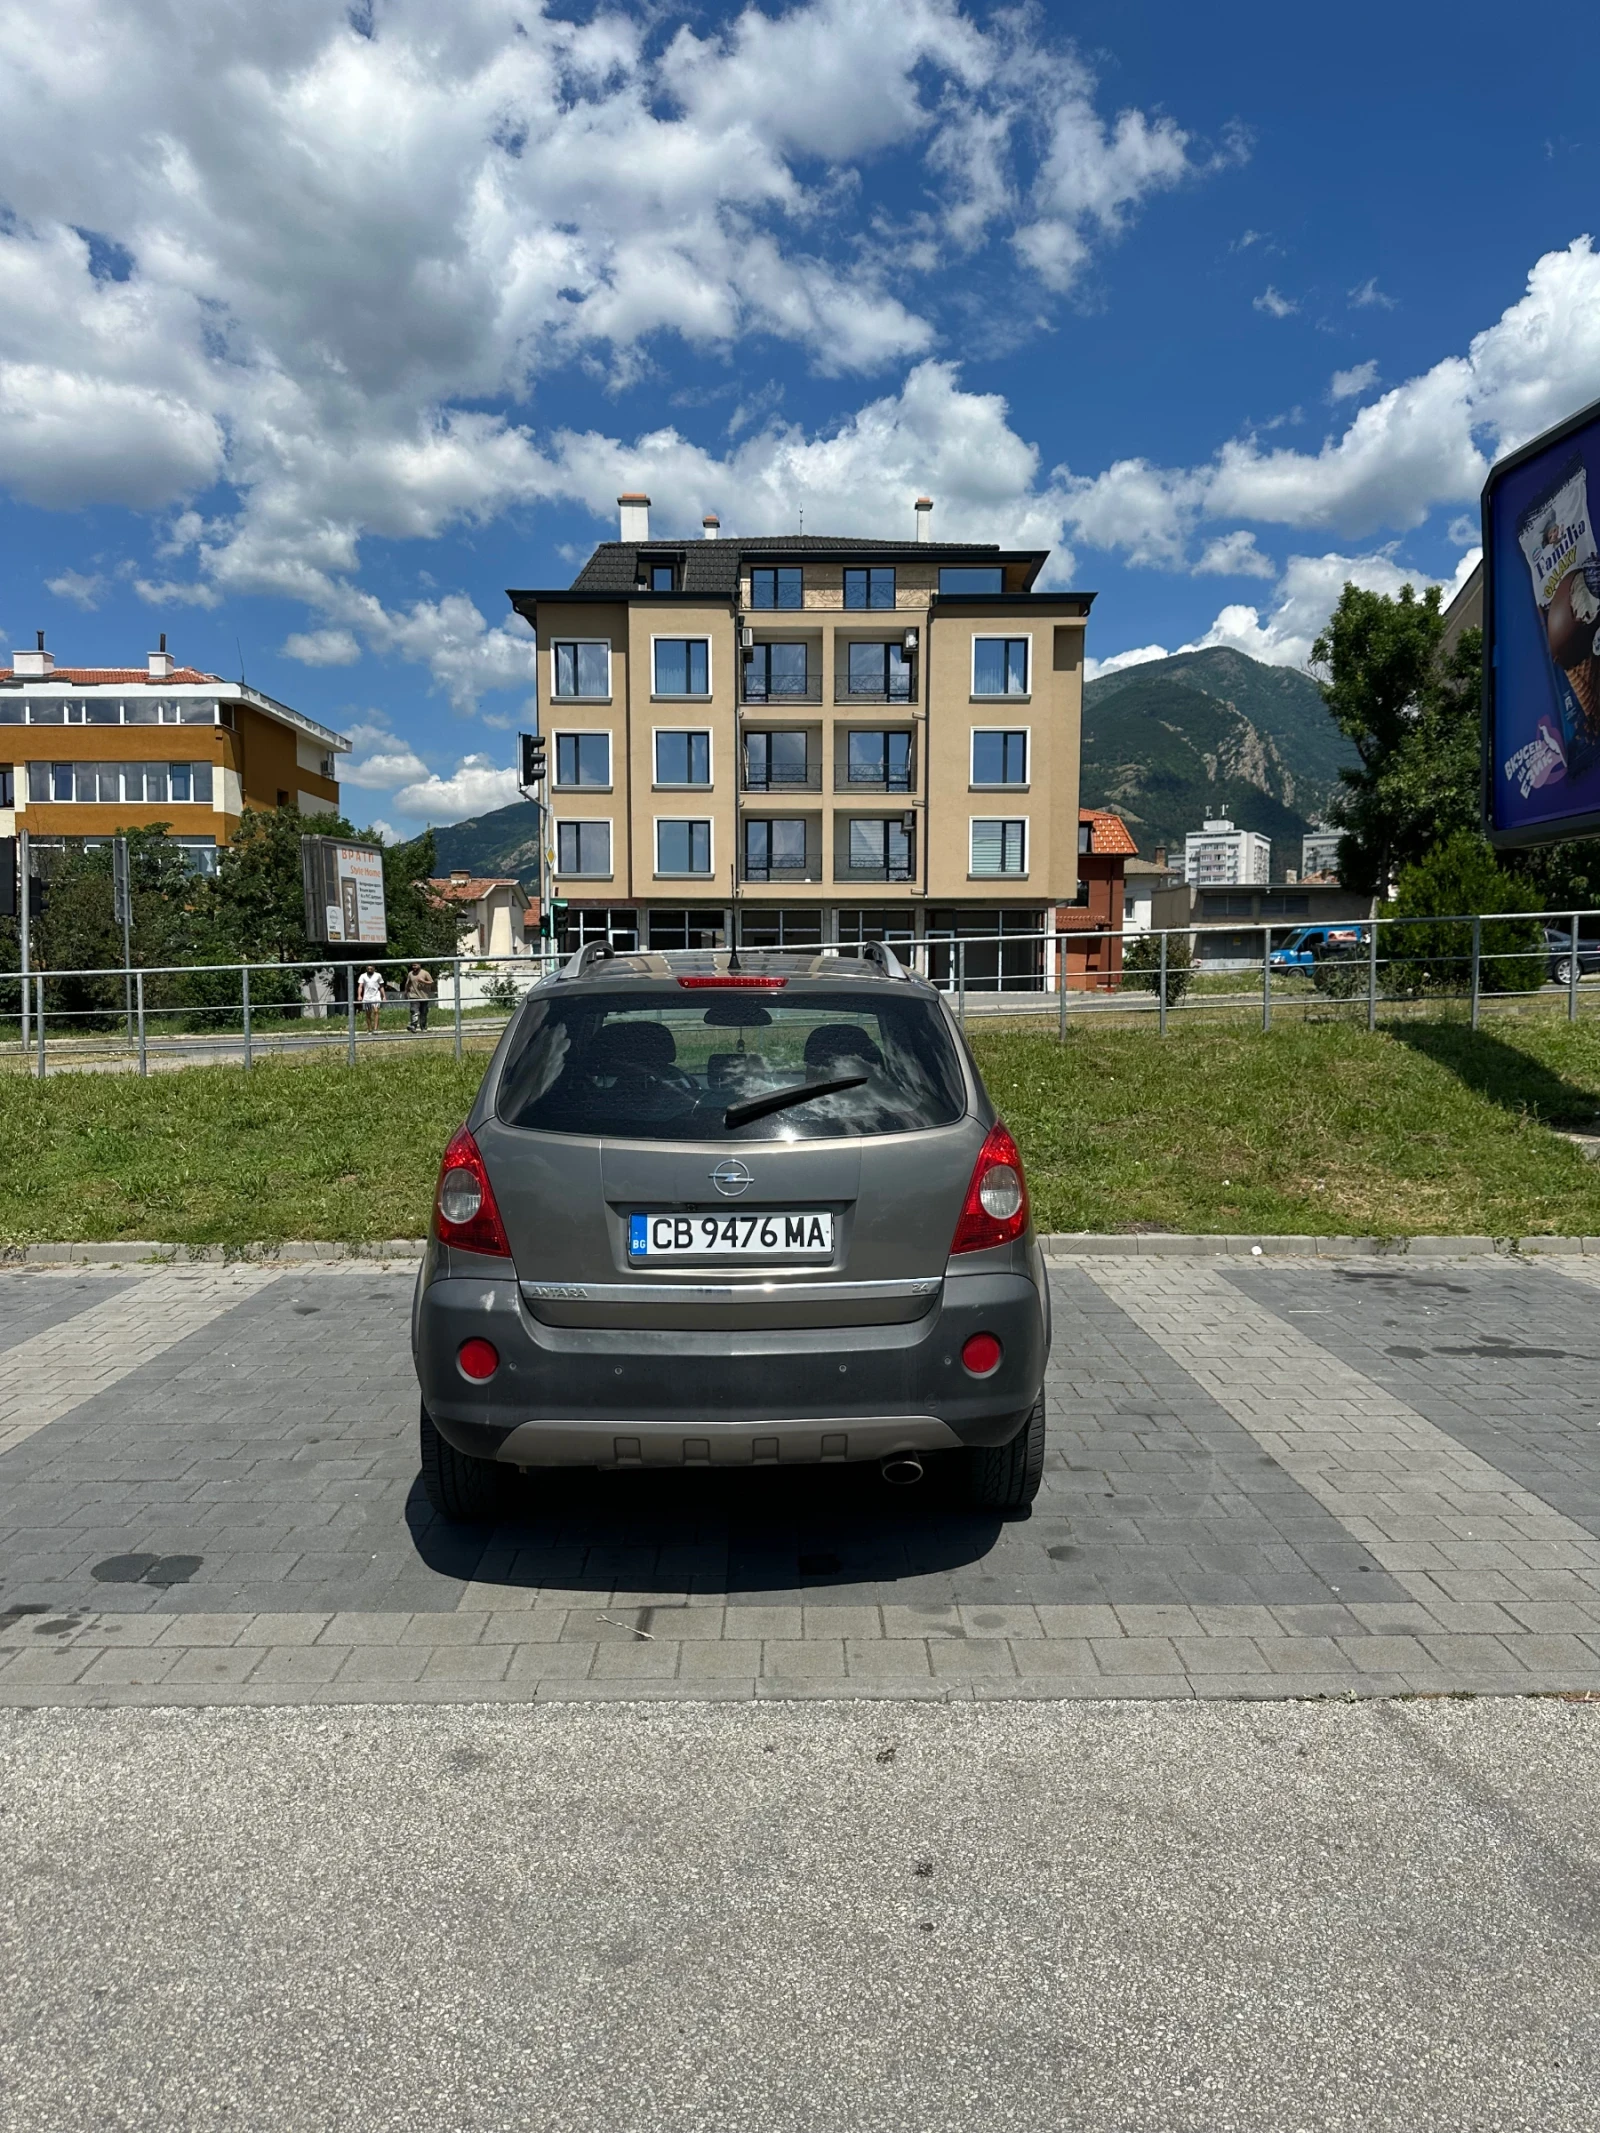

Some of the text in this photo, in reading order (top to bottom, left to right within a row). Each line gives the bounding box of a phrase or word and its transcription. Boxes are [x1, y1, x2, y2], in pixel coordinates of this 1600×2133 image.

[1535, 520, 1586, 579] Familia
[1544, 546, 1577, 599] GALAXY
[1504, 739, 1543, 782] ВКУСЕН
[1520, 751, 1553, 800] ЕЗИК
[341, 848, 374, 863] ВРАТИ
[350, 865, 381, 878] Style Home
[632, 1239, 646, 1249] BG
[652, 1216, 826, 1249] CB 9476 MA
[532, 1286, 589, 1298] ANTARA
